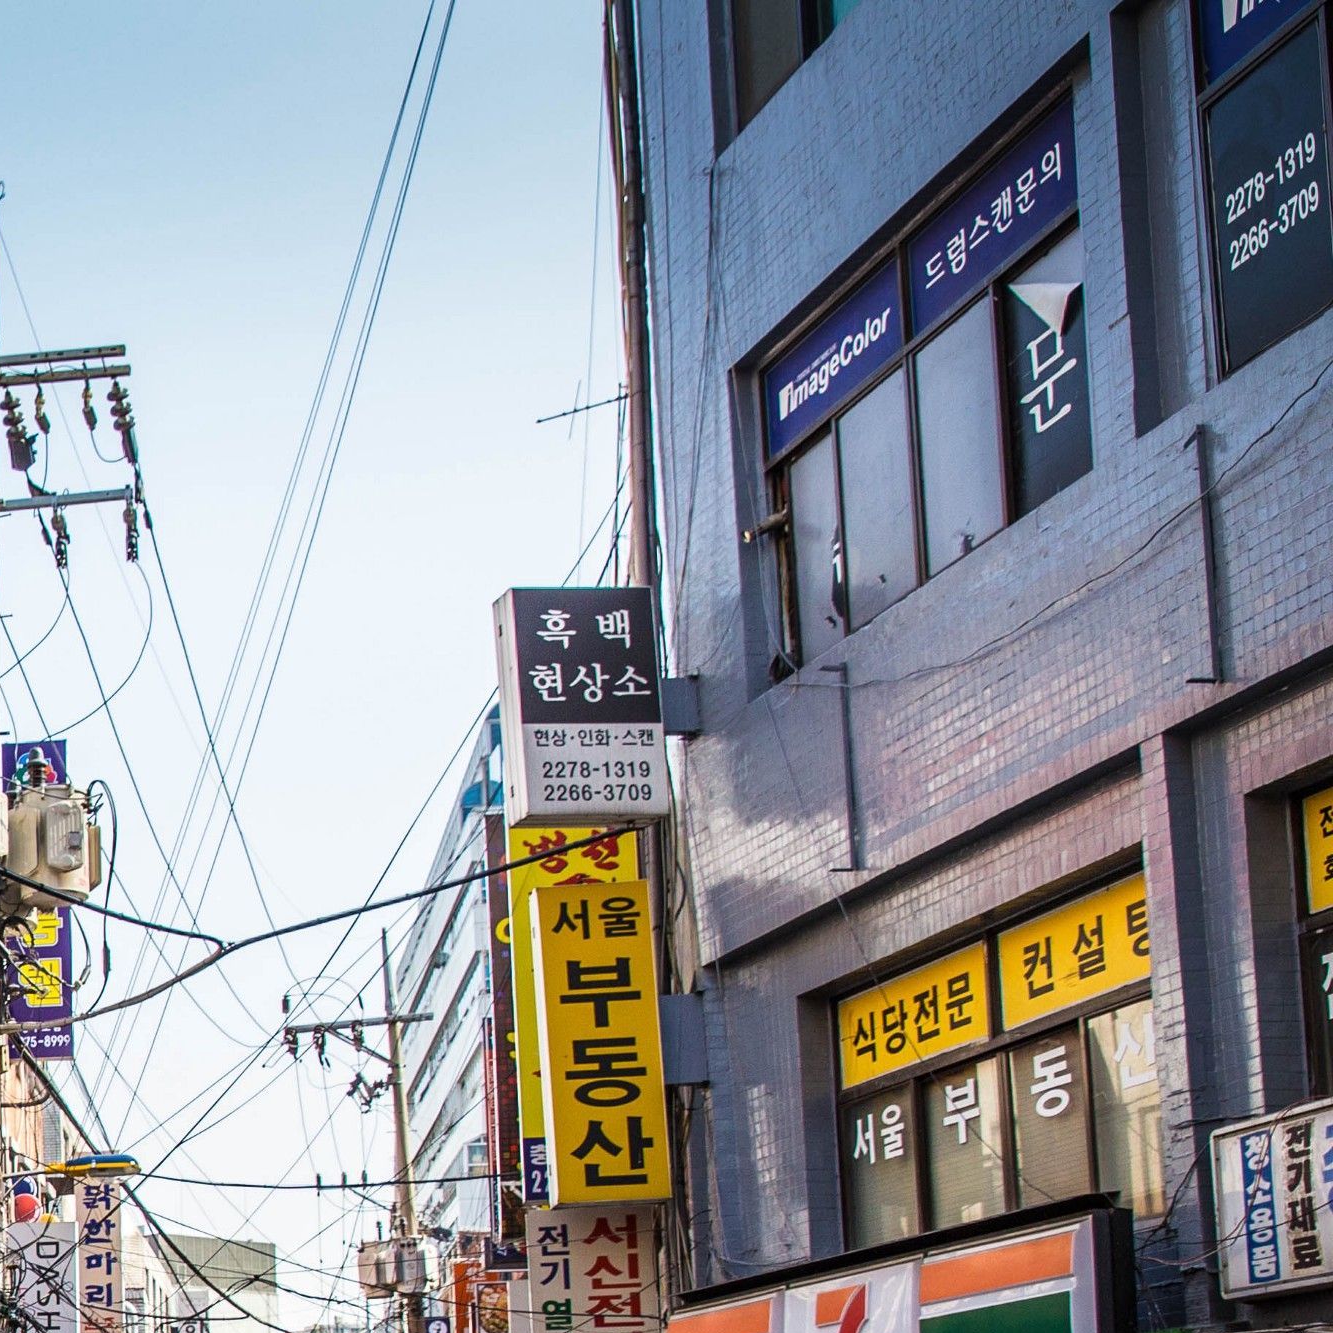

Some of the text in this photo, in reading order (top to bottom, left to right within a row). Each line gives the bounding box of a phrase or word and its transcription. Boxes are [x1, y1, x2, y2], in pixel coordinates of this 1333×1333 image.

[1224, 132, 1317, 225] 2278-1319
[1229, 180, 1320, 272] 2266-3709
[527, 661, 652, 703] 현상소
[541, 760, 651, 779] 2278-1319
[543, 783, 653, 802] 2266-3709
[551, 895, 642, 940] 서울
[852, 969, 975, 1064] 식당전문
[559, 956, 654, 1188] 부동산
[852, 1103, 906, 1165] 서울
[1284, 1123, 1324, 1271] 전기재료
[82, 1184, 114, 1309] 닭한마리
